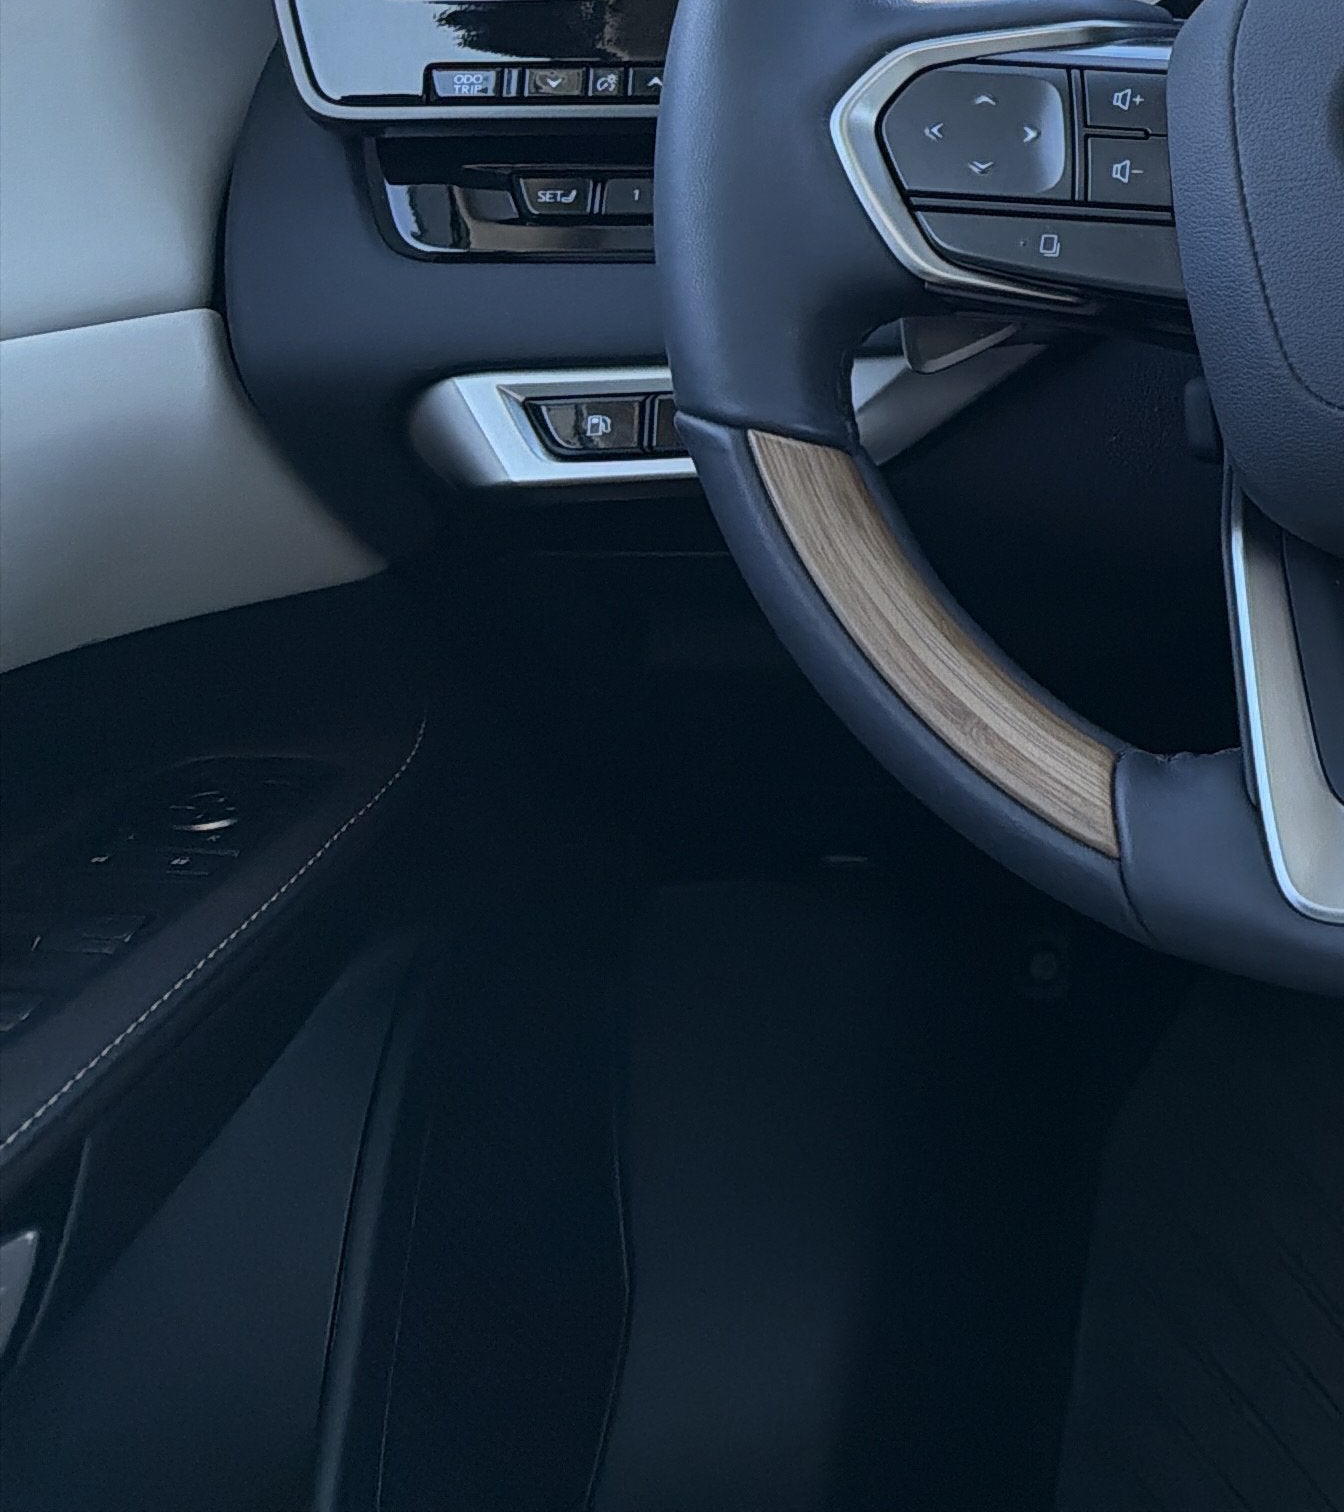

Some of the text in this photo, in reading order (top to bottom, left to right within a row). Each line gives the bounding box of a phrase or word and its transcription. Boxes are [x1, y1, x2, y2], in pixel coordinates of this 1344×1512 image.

[453, 74, 483, 85] ODO
[453, 84, 483, 95] TRIP
[537, 190, 562, 203] SET
[632, 189, 640, 200] 1
